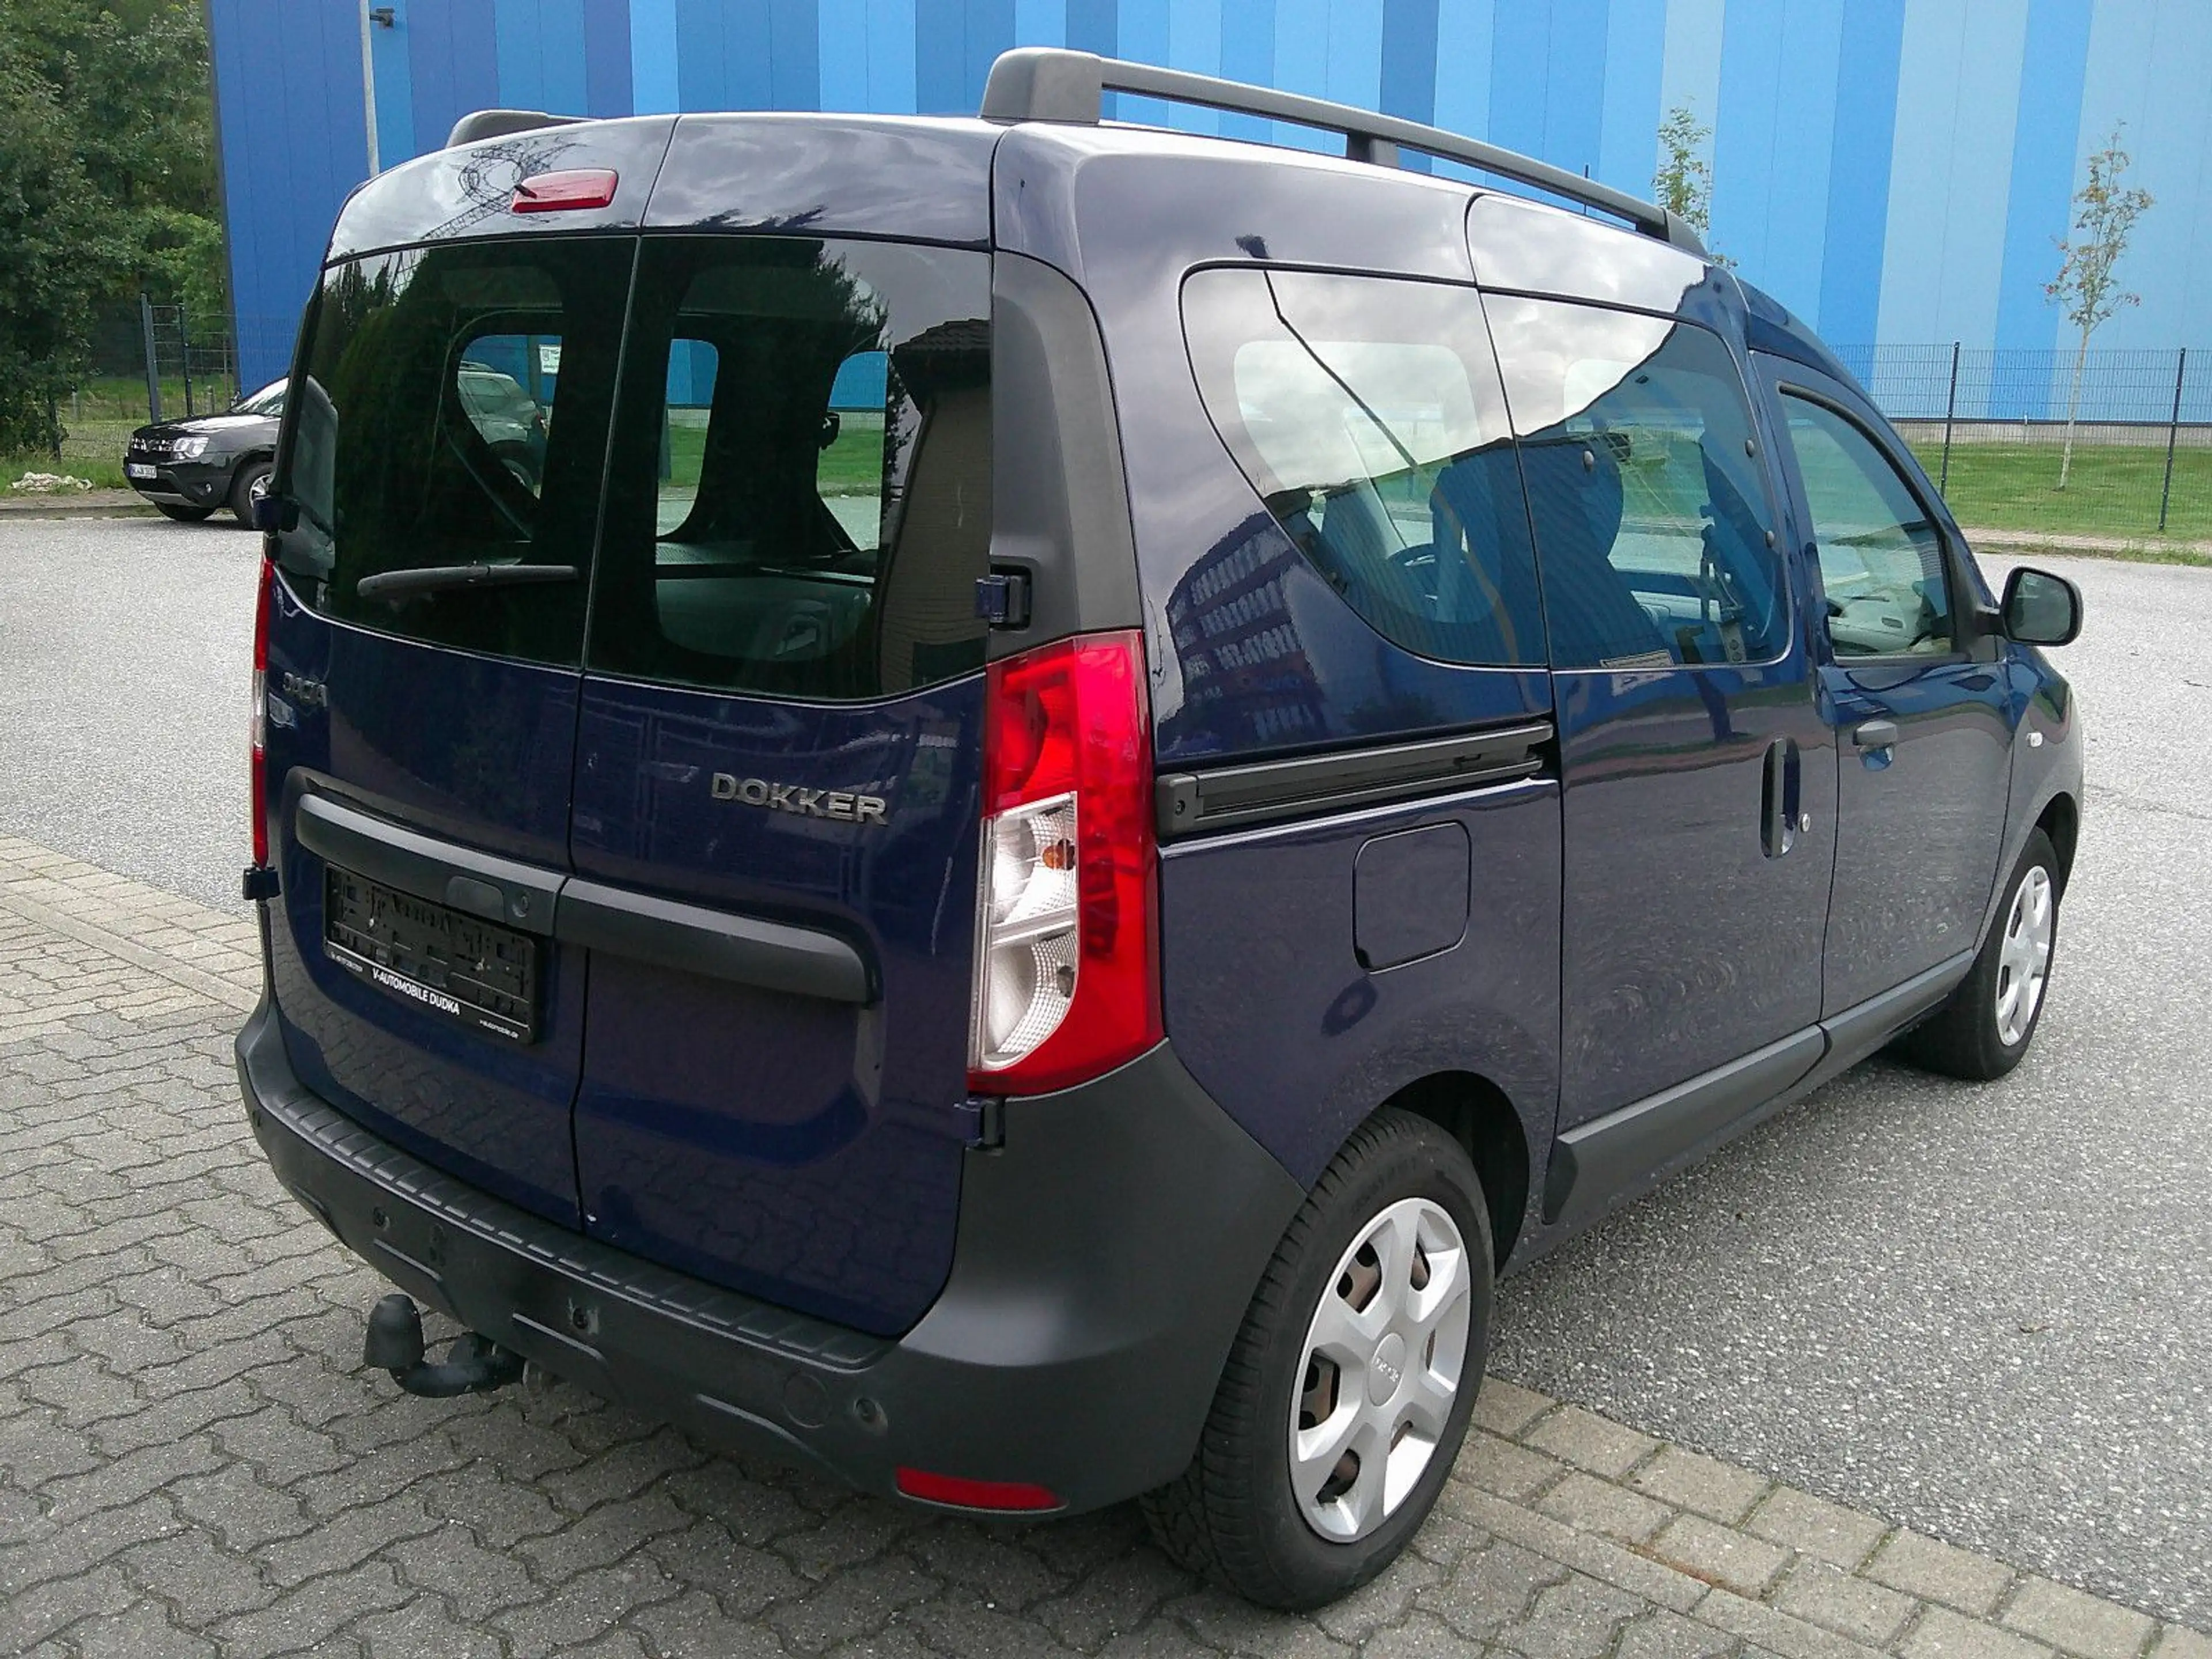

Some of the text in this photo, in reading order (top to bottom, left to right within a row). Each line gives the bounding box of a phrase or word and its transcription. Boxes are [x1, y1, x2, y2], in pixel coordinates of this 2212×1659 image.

[711, 772, 889, 826] DOKKER
[372, 967, 460, 1016] V-AUTOMOBILE DUDKA
